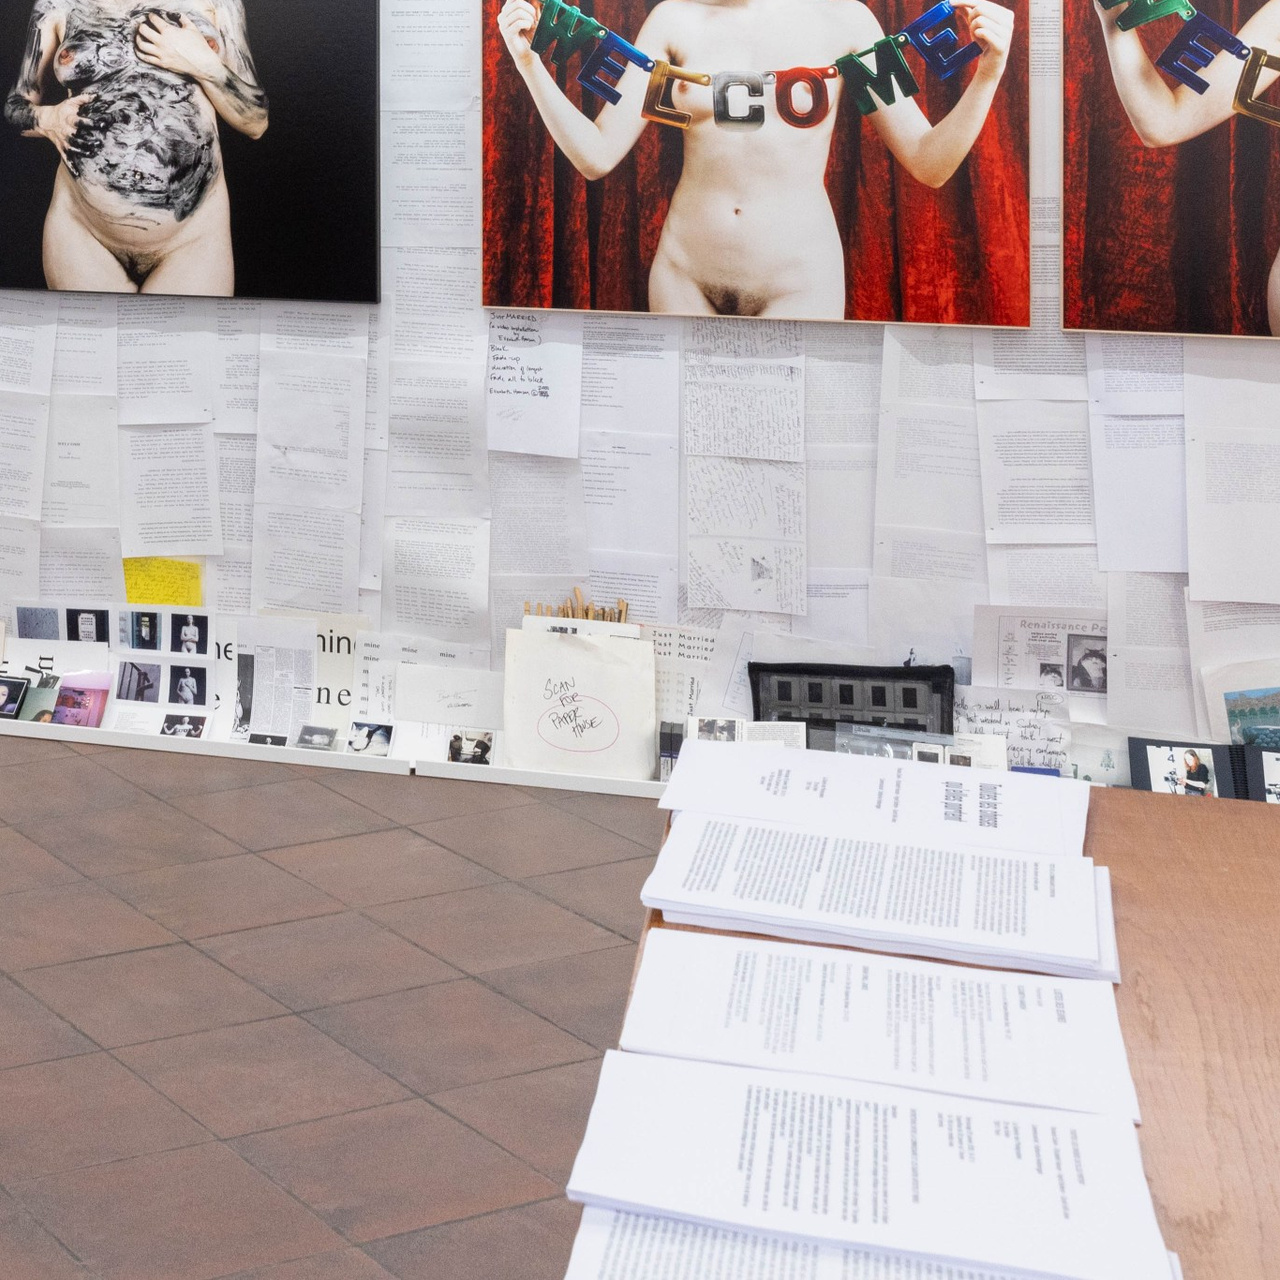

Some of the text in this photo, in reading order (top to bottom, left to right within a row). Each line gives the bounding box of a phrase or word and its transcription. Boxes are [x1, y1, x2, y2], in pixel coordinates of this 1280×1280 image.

[1020, 620, 1088, 632] Renaissance
[678, 633, 715, 643] Married
[364, 641, 456, 659] mine mine mine
[678, 642, 714, 653] Married
[678, 651, 711, 662] Marrie
[543, 676, 575, 700] SCAN
[316, 686, 352, 707] ne
[559, 692, 583, 707] FOR
[548, 707, 583, 730] PAPER
[1016, 719, 1041, 736] Sydney
[1167, 754, 1175, 763] 4
